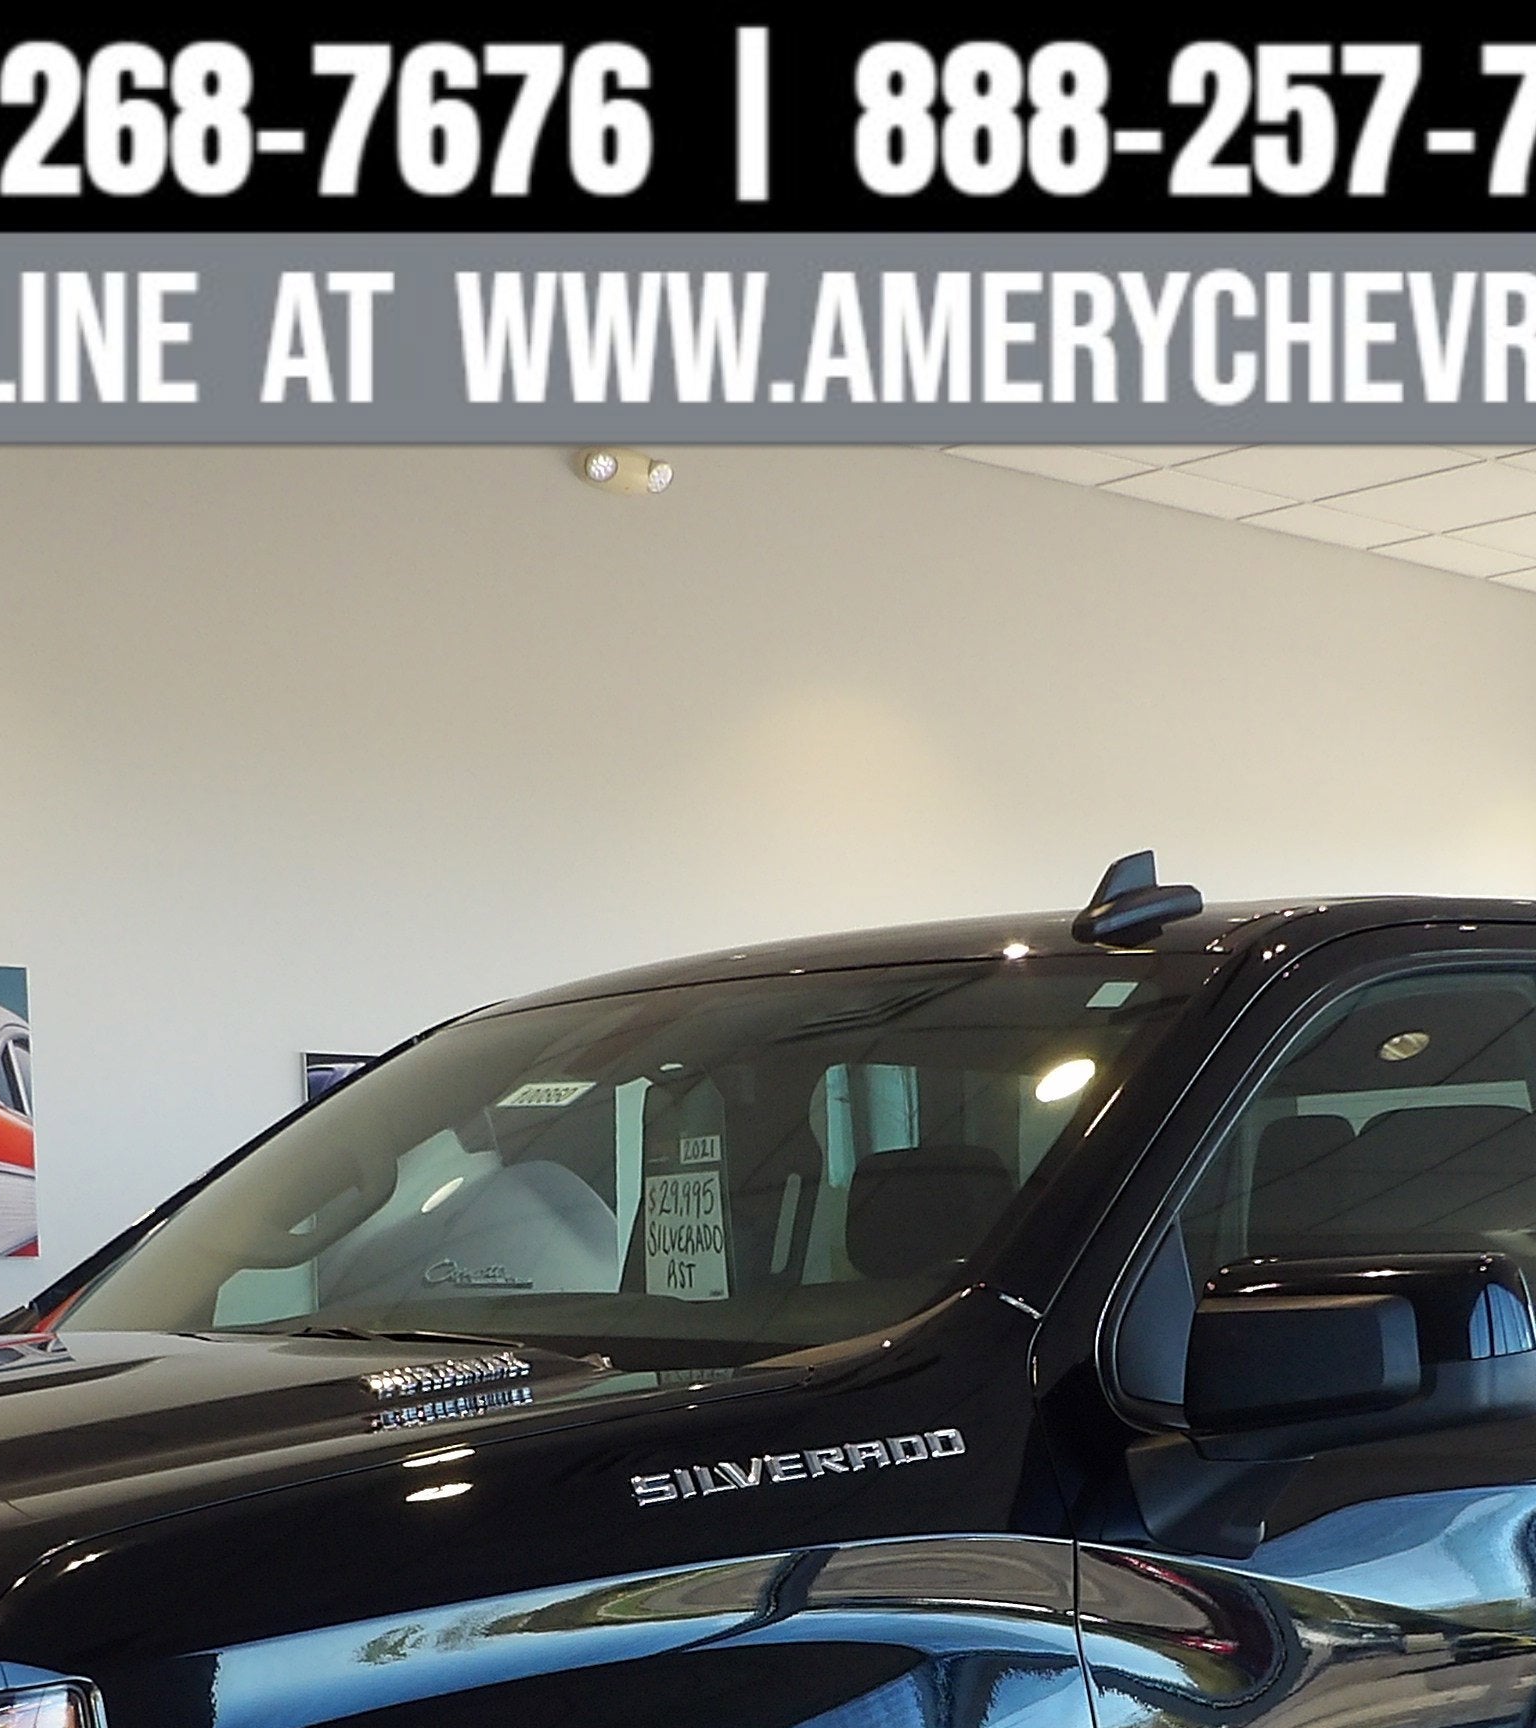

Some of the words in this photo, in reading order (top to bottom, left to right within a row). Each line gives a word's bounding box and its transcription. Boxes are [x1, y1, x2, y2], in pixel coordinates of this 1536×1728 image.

[682, 1137, 716, 1162] 2021
[647, 1177, 715, 1220] $29,995
[647, 1220, 724, 1258] SILVERADO
[630, 1428, 967, 1507] SILVERADO
